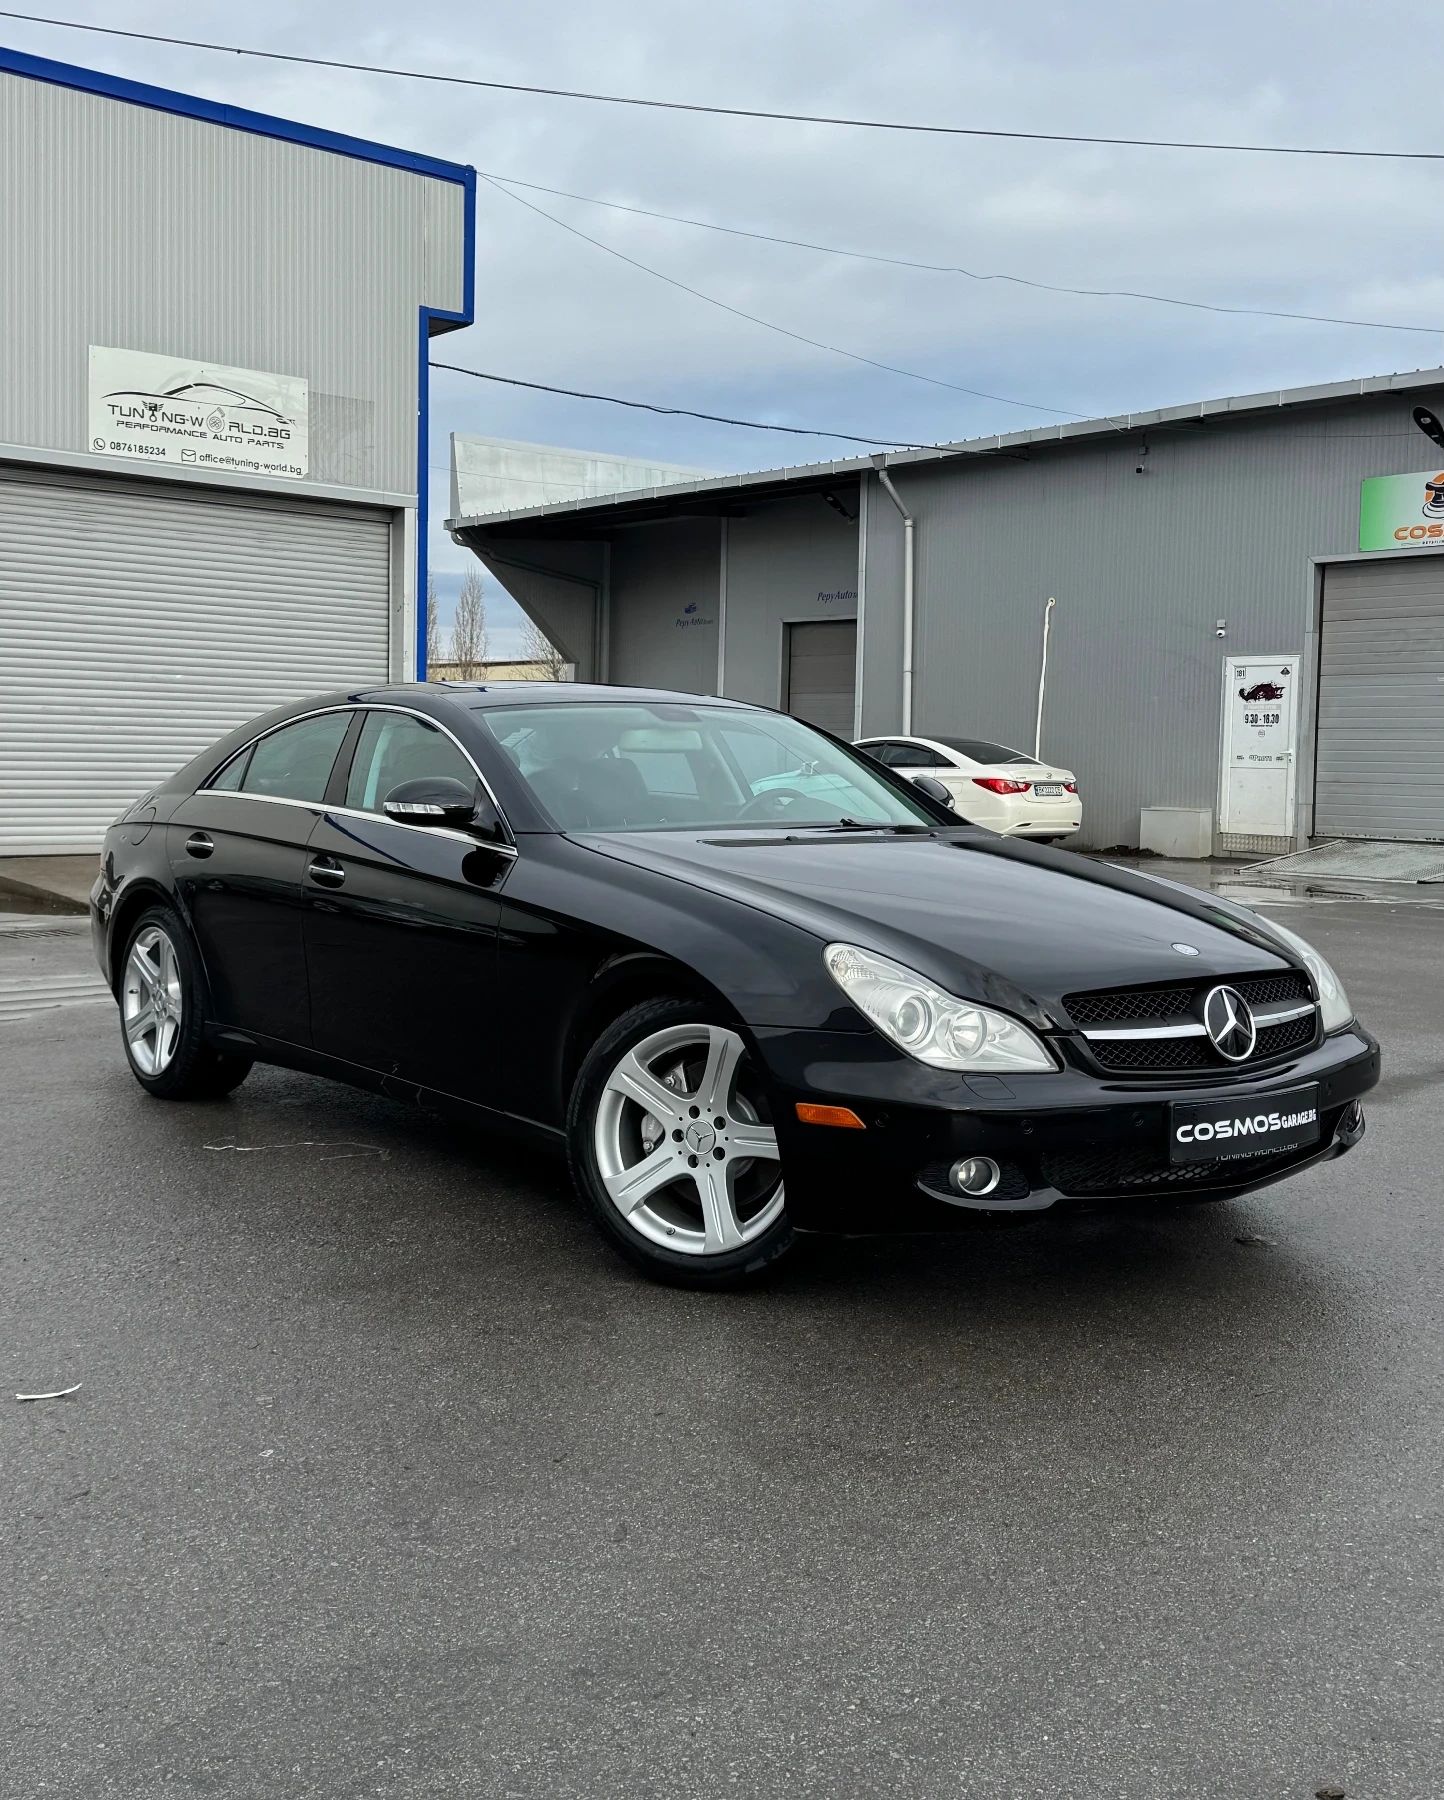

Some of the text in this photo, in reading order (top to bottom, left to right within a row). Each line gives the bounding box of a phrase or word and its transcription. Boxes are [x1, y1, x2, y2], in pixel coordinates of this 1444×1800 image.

[116, 420, 285, 450] PERFORMANCE AUTO PARTS
[109, 441, 166, 456] 0876185234
[199, 454, 302, 475] office@tuning-world.bg
[1394, 524, 1444, 540] COS
[816, 591, 835, 604] Pepy
[834, 590, 853, 600] Auto
[675, 618, 689, 629] Pepy
[1244, 713, 1259, 724] 9.30
[1263, 713, 1280, 724] 18.30
